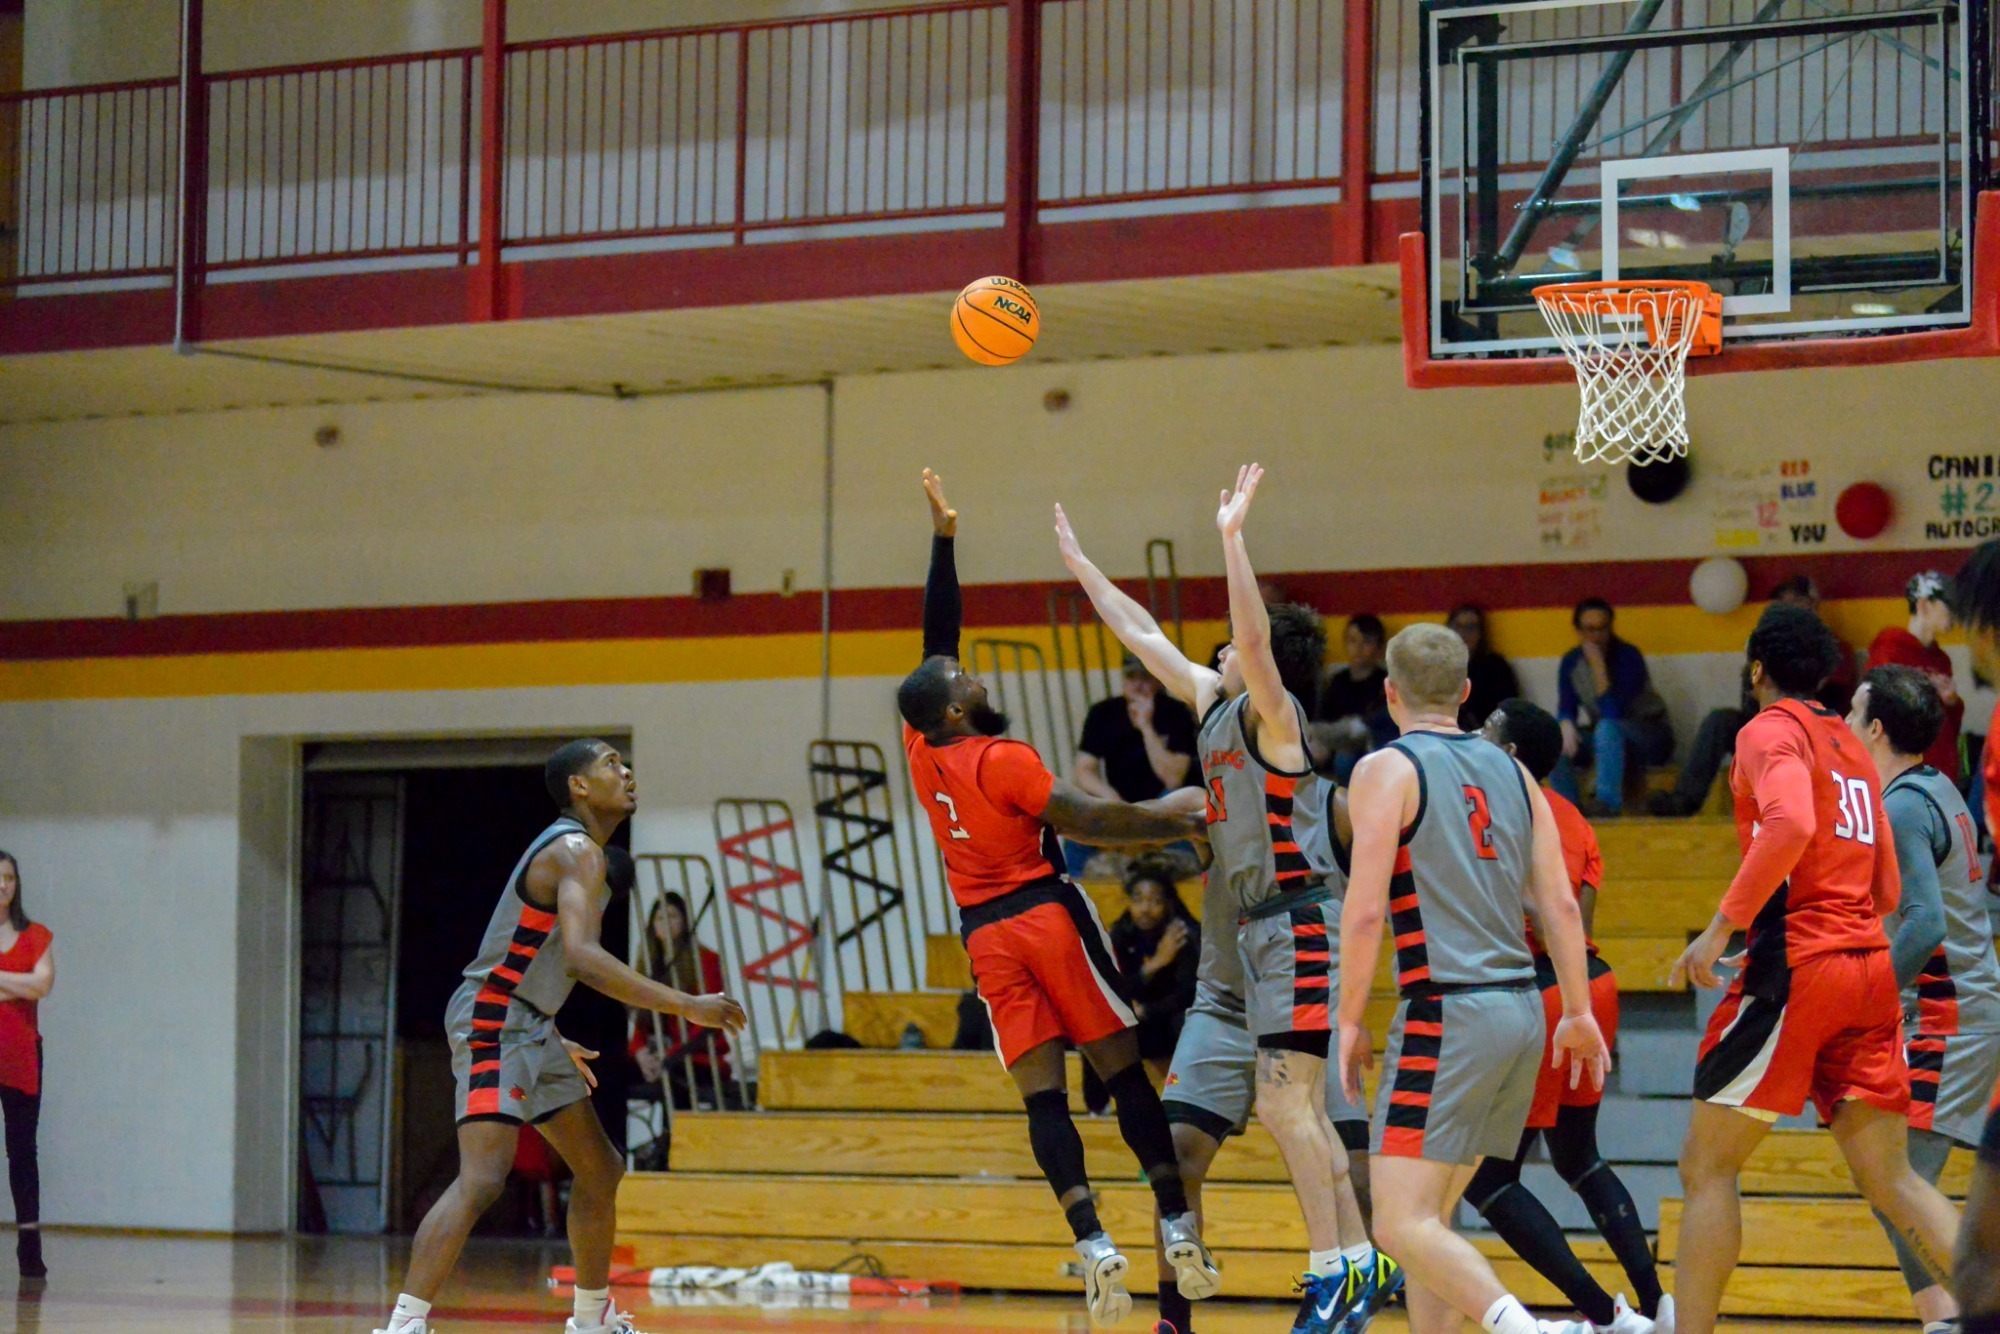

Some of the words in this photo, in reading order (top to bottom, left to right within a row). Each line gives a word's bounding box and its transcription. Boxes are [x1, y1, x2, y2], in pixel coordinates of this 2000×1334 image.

[993, 295, 1032, 325] NCAA
[1789, 523, 1827, 544] YOU
[1461, 784, 1499, 861] 2
[1830, 769, 1875, 846] 30
[1955, 812, 1983, 883] 11
